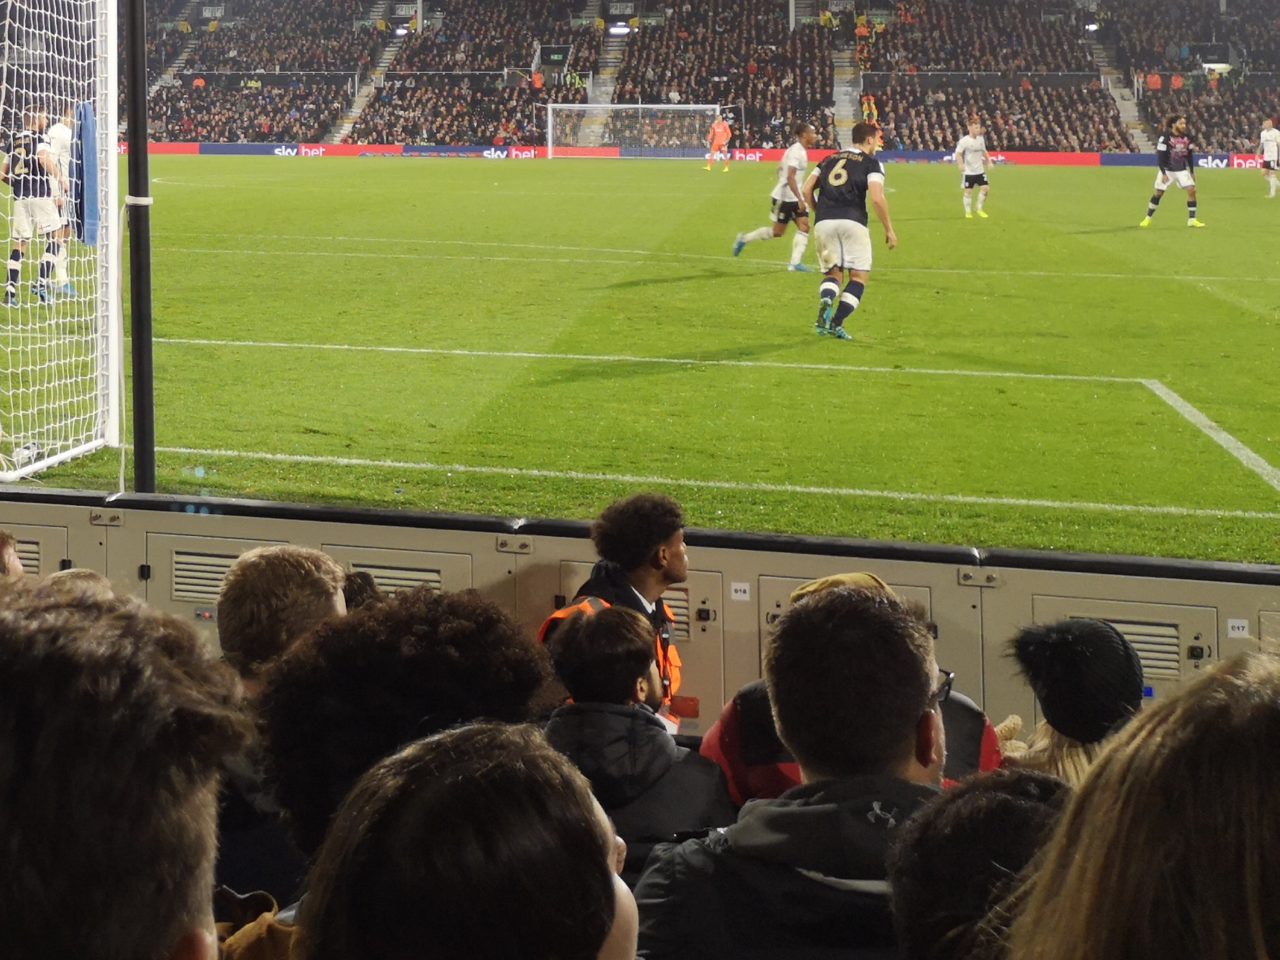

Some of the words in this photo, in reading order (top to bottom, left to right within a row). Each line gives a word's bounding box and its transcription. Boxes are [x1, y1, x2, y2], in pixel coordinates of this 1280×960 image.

[274, 145, 298, 157] sky
[301, 145, 326, 157] bet
[483, 147, 508, 159] sky
[734, 151, 763, 162] bet
[1198, 155, 1228, 168] sky
[1233, 156, 1265, 169] bet
[828, 158, 849, 187] 6
